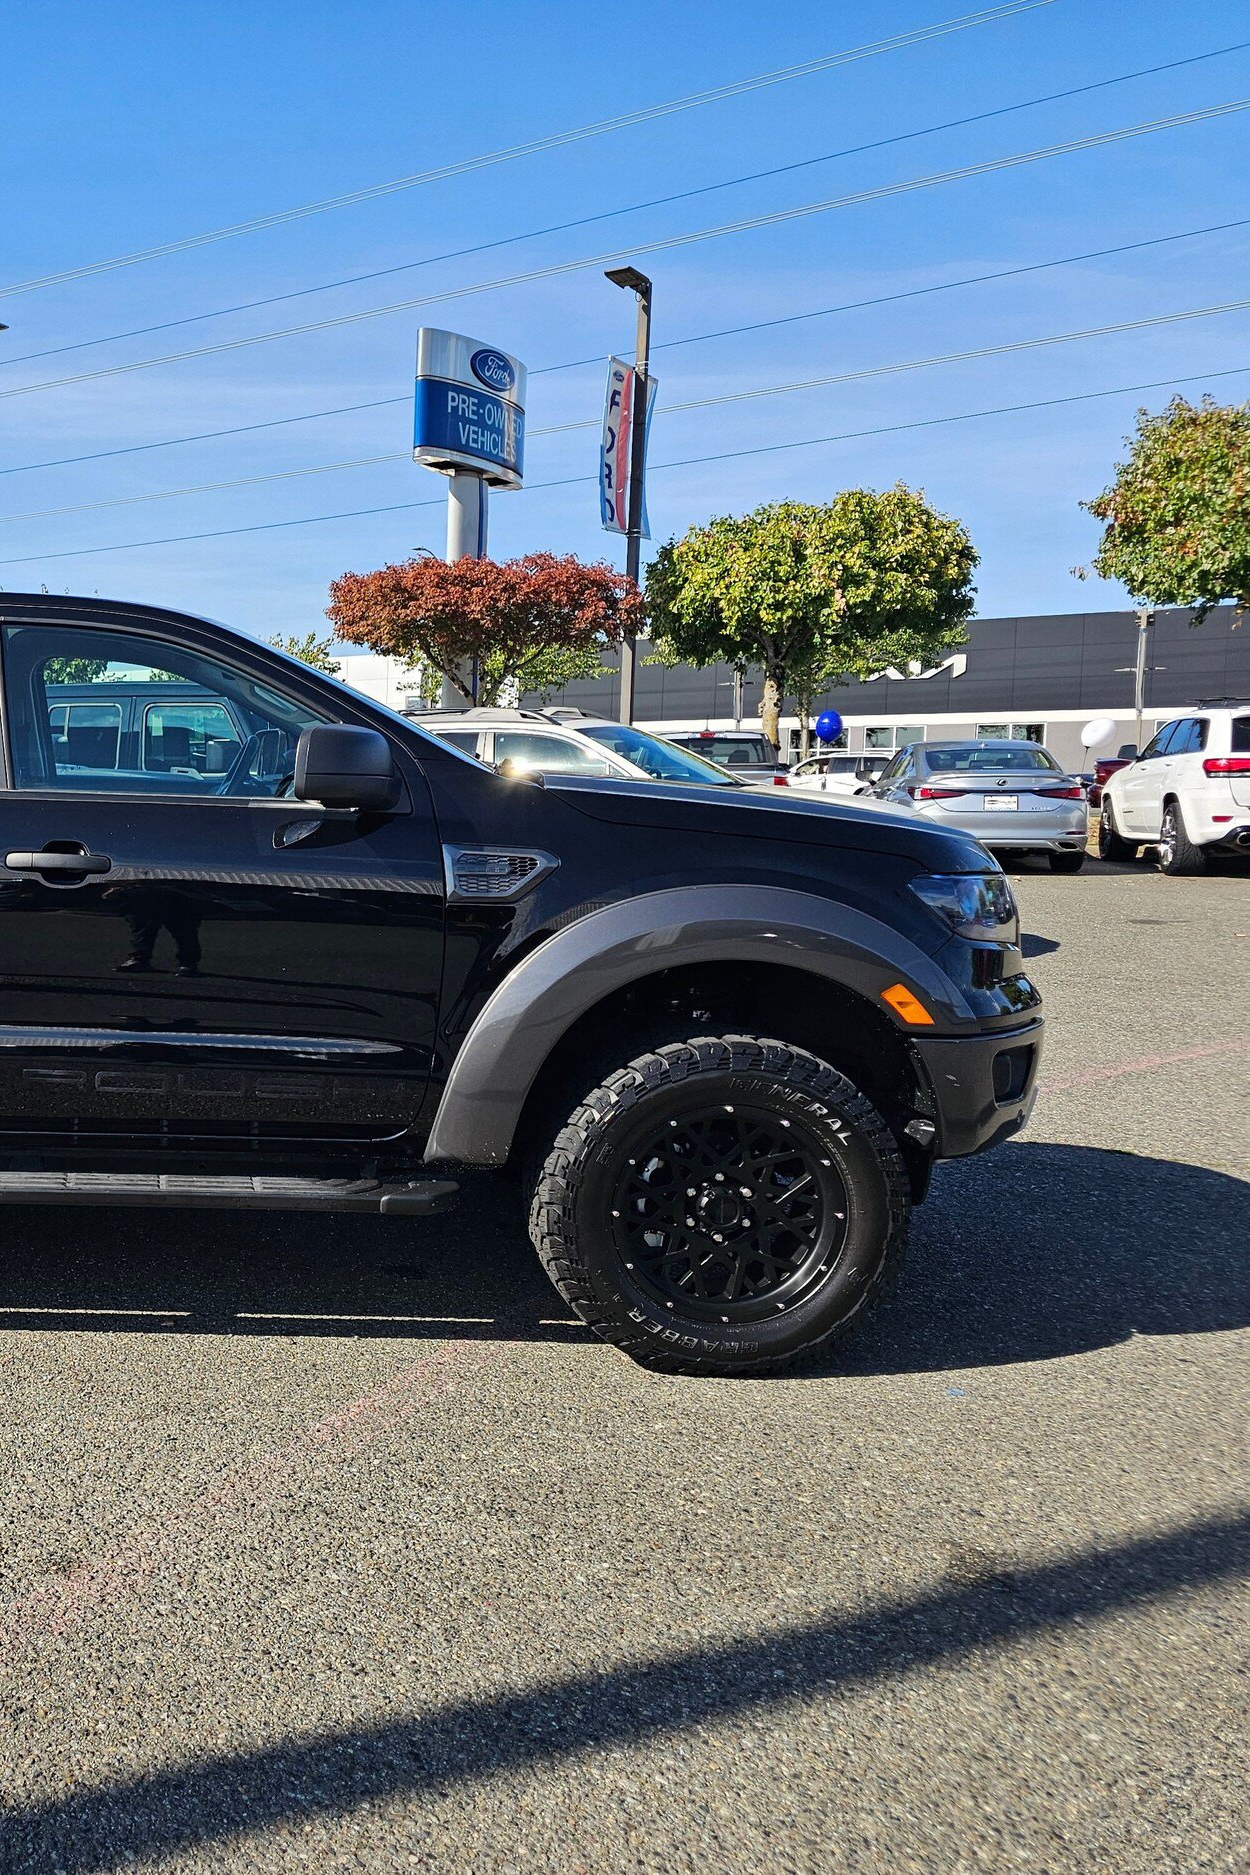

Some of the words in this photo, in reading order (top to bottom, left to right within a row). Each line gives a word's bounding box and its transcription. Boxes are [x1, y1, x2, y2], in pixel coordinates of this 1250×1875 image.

[484, 355, 511, 384] Ford
[447, 391, 523, 439] PRE-OWNED
[458, 421, 517, 463] VEHICLES
[729, 1077, 853, 1147] GENERAL
[626, 1306, 760, 1354] GRABBER
